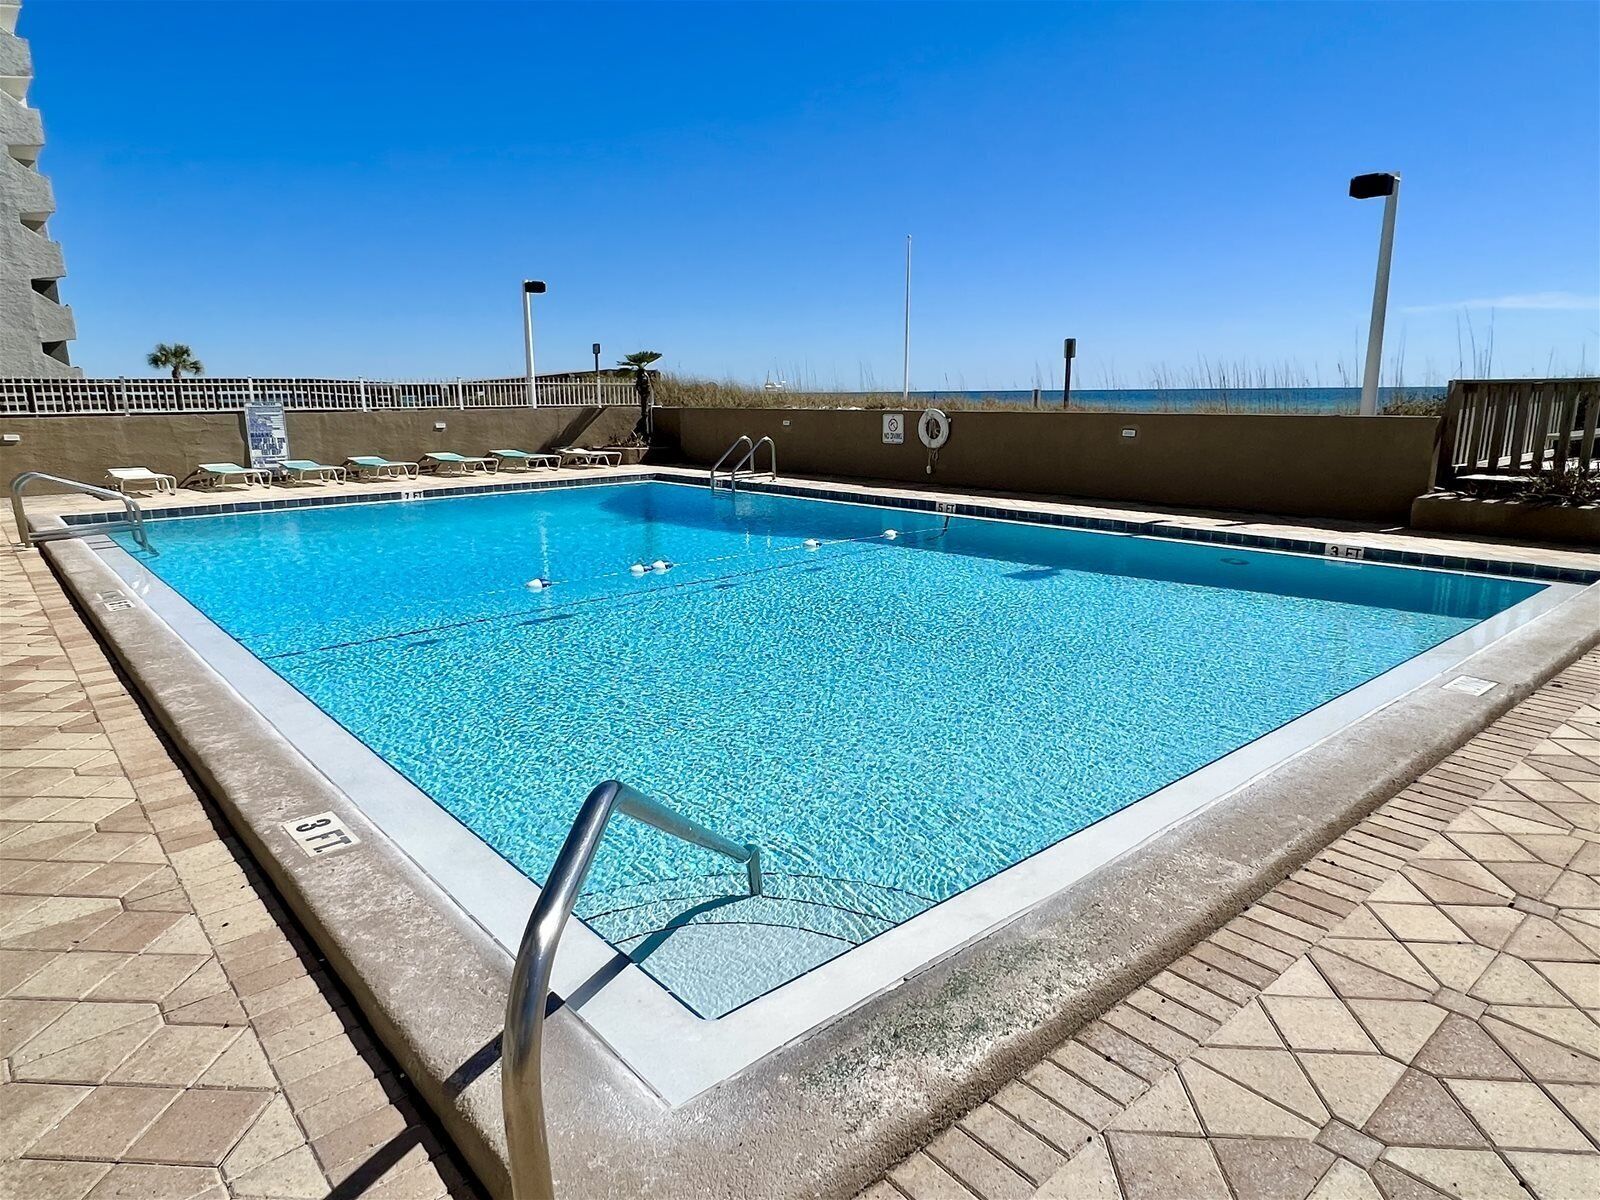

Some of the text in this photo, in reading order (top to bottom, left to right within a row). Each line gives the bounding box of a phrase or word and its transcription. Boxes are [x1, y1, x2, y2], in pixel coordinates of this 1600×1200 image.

[938, 503, 955, 513] 5 FT
[1330, 546, 1362, 559] 3 FT
[296, 819, 352, 853] 3 FT.
